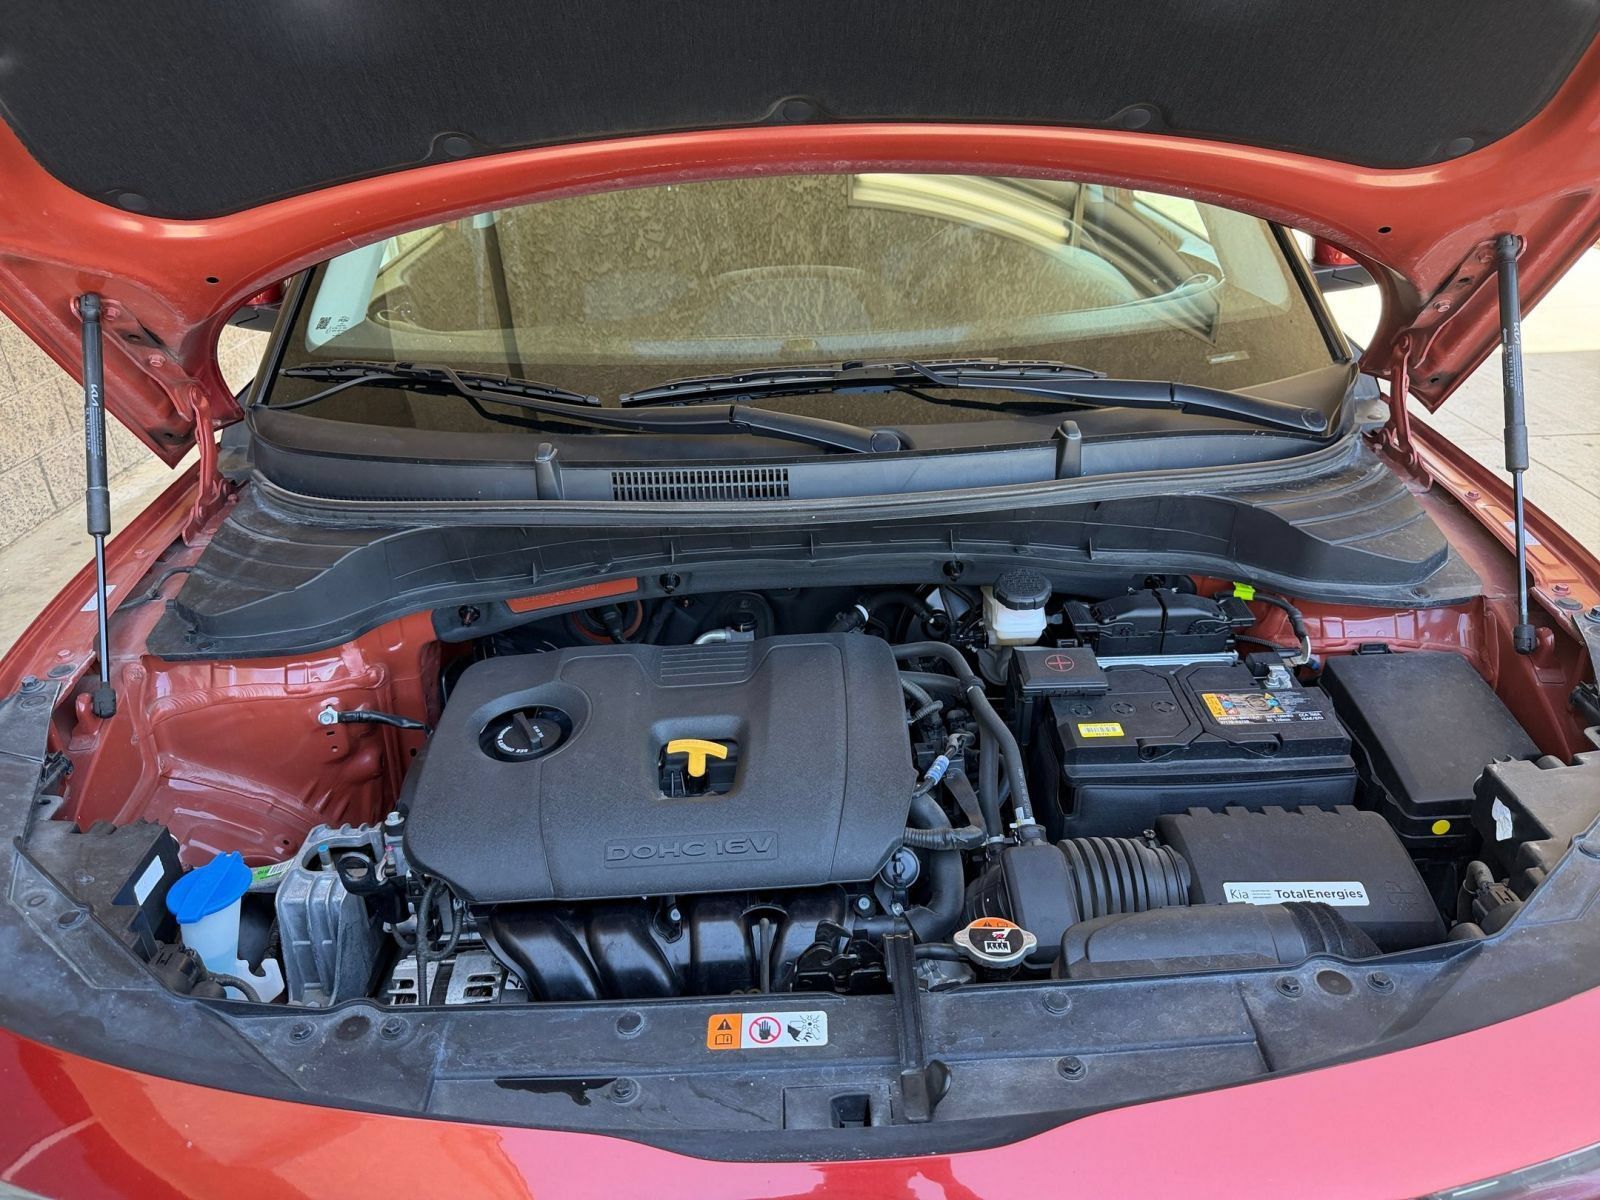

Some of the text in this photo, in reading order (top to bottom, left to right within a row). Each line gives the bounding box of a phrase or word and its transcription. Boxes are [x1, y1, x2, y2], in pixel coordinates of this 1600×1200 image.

[606, 837, 773, 861] DOHC 16V
[1230, 889, 1363, 901] Kia TotalEnergies
